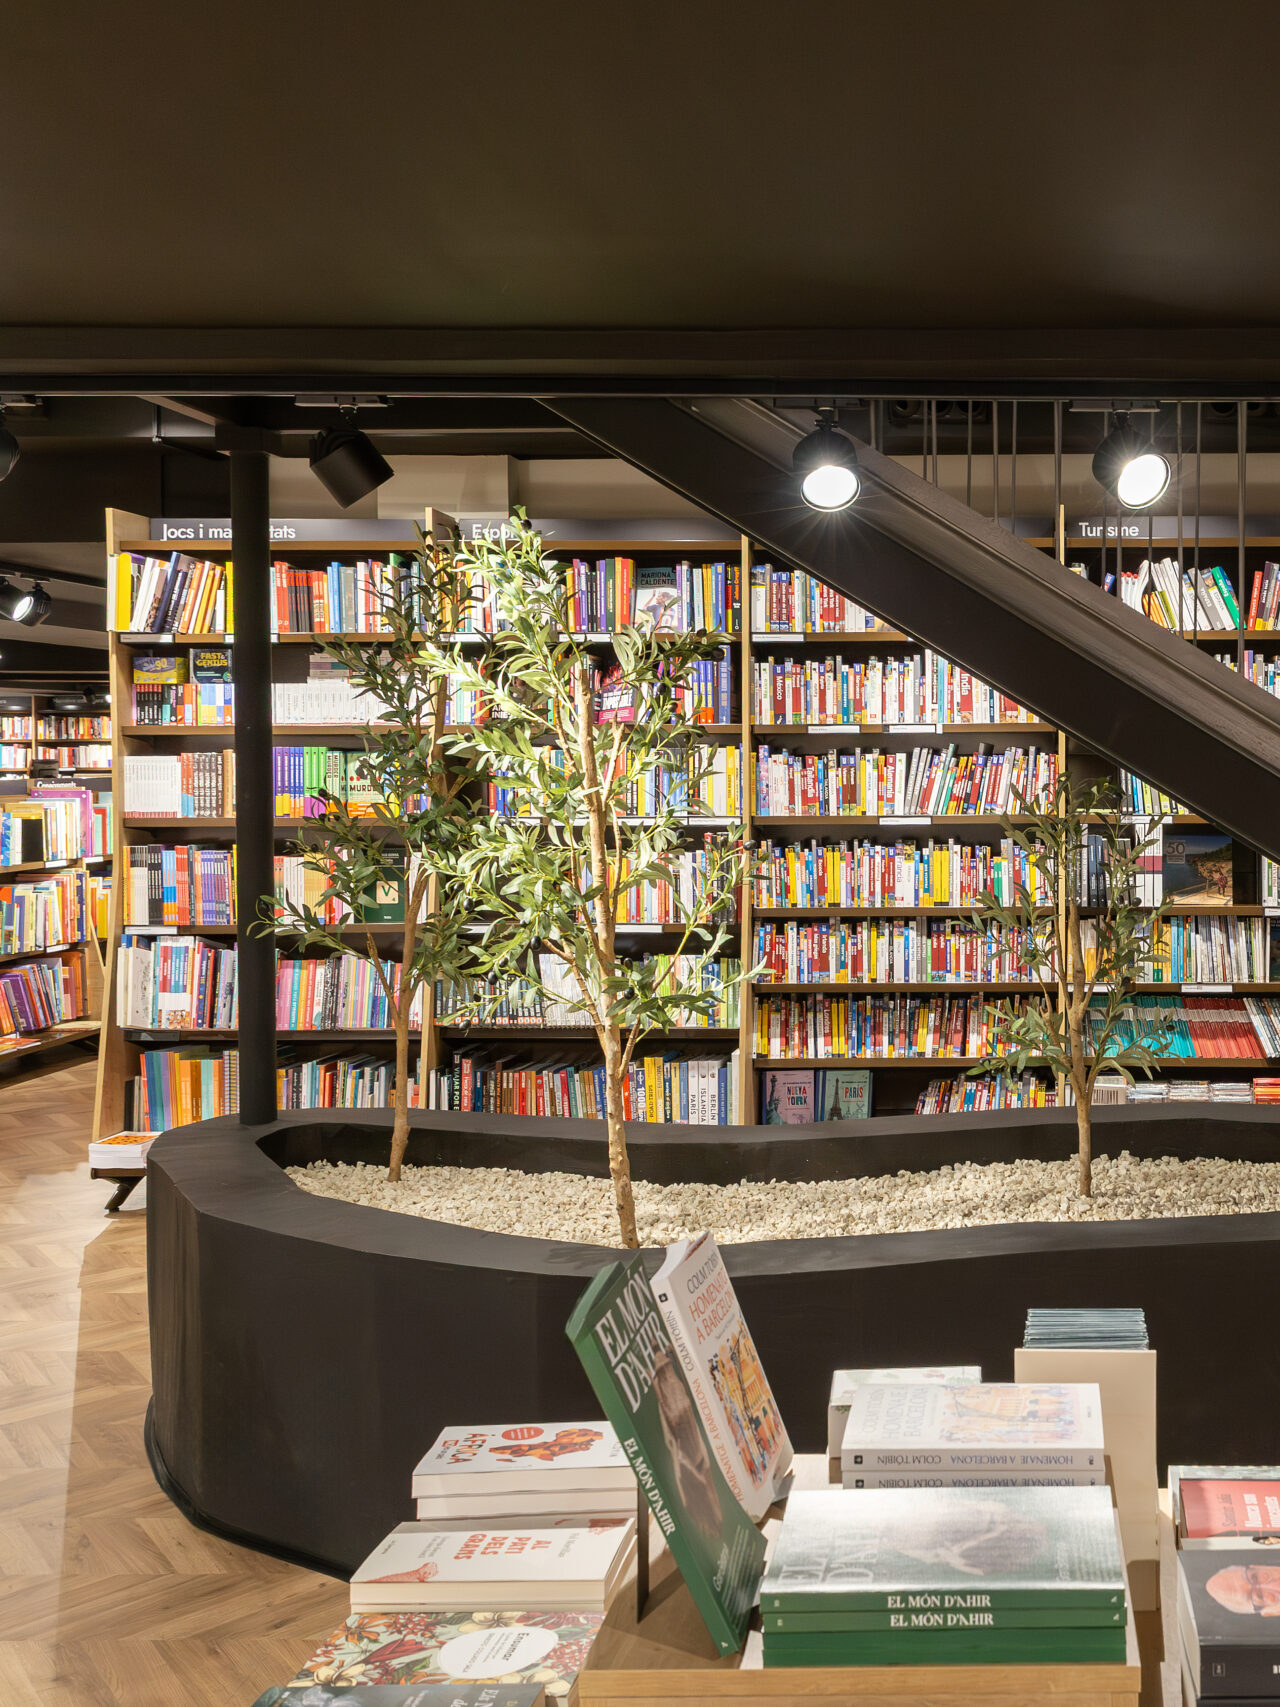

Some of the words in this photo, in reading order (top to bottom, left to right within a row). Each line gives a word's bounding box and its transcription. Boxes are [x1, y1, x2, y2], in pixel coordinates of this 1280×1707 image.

[160, 523, 195, 541] Jocs
[199, 523, 204, 539] i
[1078, 522, 1139, 537] Tursme
[197, 659, 229, 667] GENIUS
[960, 673, 971, 696] India
[807, 765, 815, 798] Tailandia
[886, 765, 895, 798] Alemania
[1166, 842, 1186, 855] 50
[896, 856, 904, 883] Francia
[381, 884, 392, 897] V
[823, 1009, 831, 1033] Londres
[453, 1067, 461, 1089] VIAJAR
[453, 1090, 461, 1103] POR
[637, 1086, 646, 1108] 1000
[786, 1085, 807, 1096] NUEVA
[786, 1095, 808, 1106] YORK
[595, 1309, 630, 1368] EL
[616, 1266, 654, 1340] MÓN
[613, 1311, 672, 1413] D'AHIR
[680, 1342, 695, 1372] COLM
[692, 1377, 721, 1434] BARCELONA
[911, 1455, 942, 1464] COLM
[950, 1455, 1009, 1465] BARCELONA
[1020, 1455, 1073, 1465] HOMENAJE
[716, 1443, 745, 1502] HOMENATGE
[623, 1437, 636, 1458] EL
[635, 1456, 656, 1490] MÓN
[647, 1487, 677, 1537] D'AHIR
[453, 1532, 487, 1559] GRANS
[480, 1535, 509, 1554] DELS
[504, 1535, 532, 1553] PATI
[530, 1539, 553, 1549] AL
[887, 1595, 906, 1609] EL
[908, 1592, 942, 1608] MÓN
[944, 1594, 992, 1608] D'AHIR
[890, 1614, 909, 1627] EL
[909, 1611, 943, 1627] MÓN
[947, 1613, 994, 1627] D'AHIR
